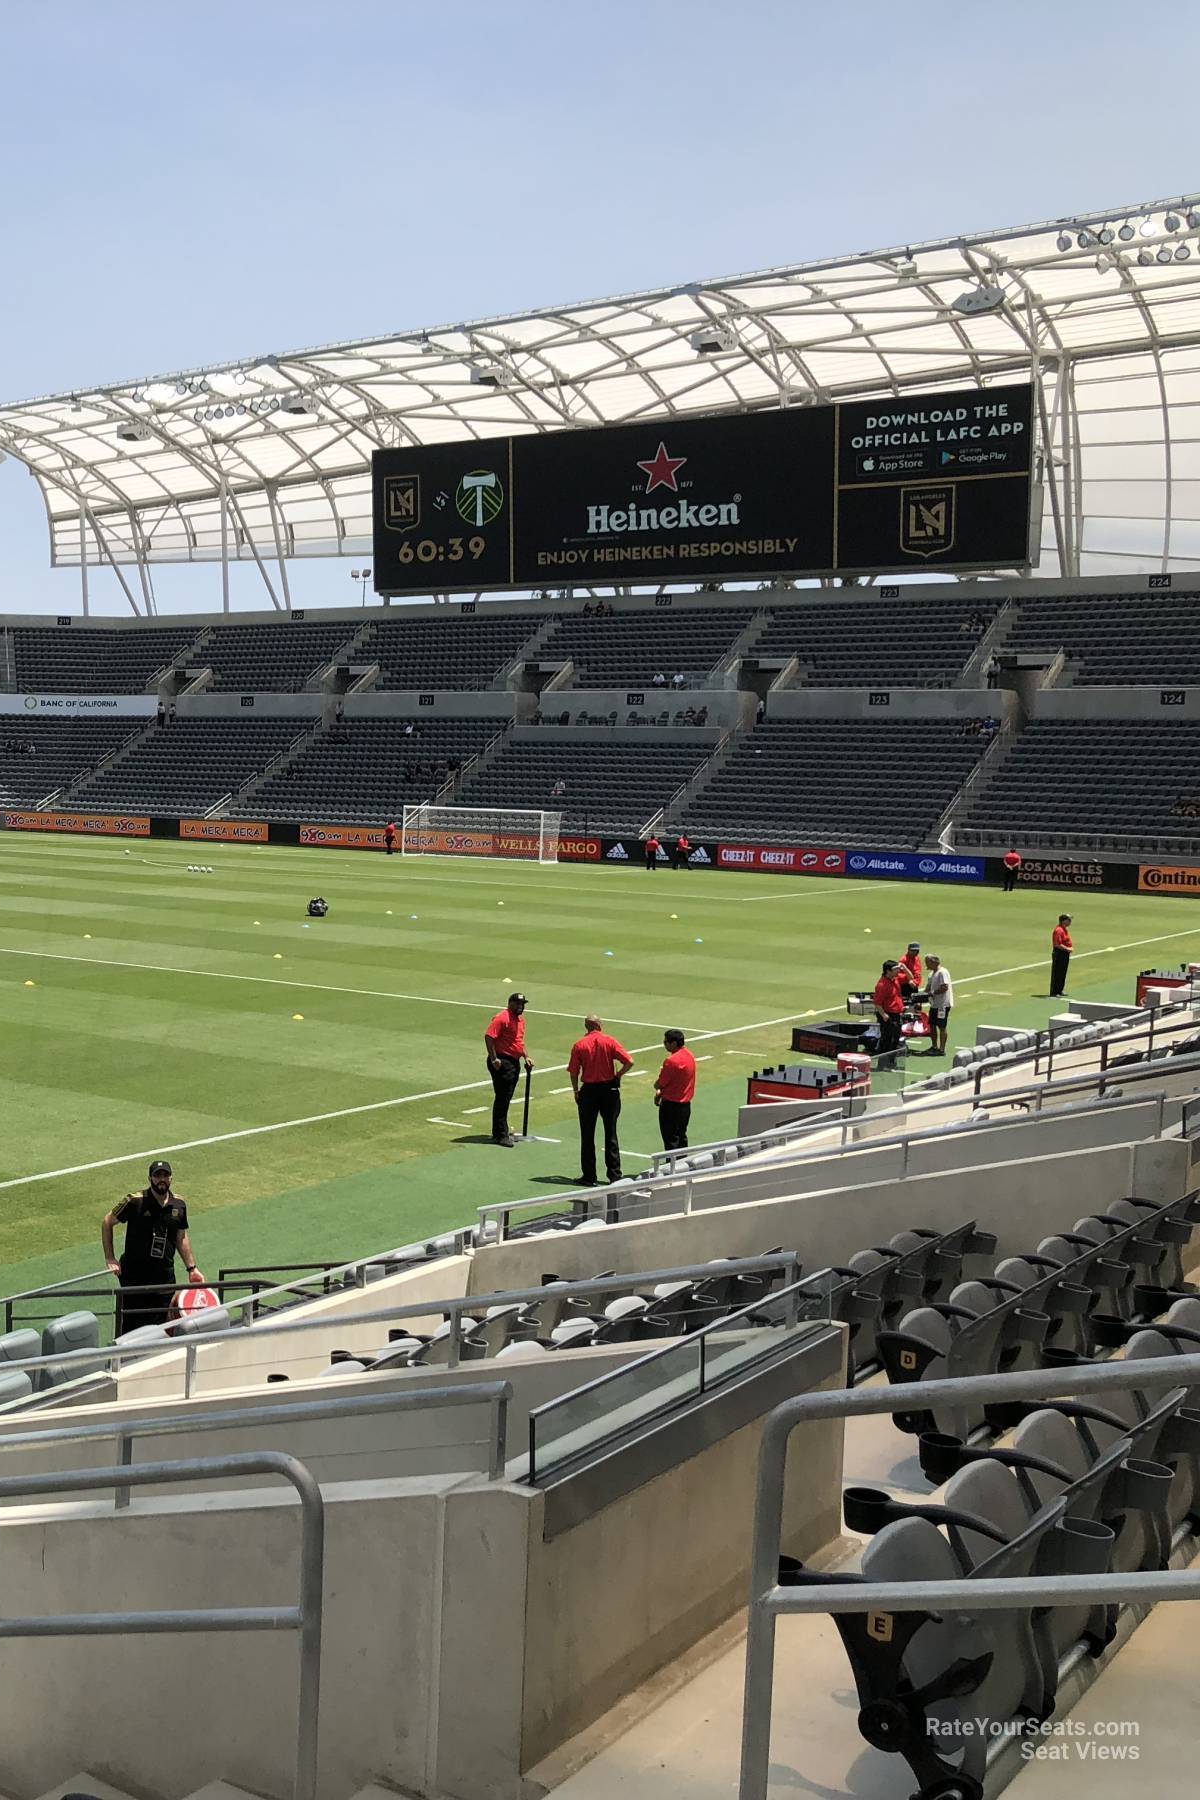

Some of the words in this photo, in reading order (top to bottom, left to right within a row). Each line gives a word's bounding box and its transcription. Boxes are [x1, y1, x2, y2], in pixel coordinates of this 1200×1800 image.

[866, 408, 967, 430] DOWNLOAD
[973, 403, 1009, 420] THE
[851, 430, 930, 449] OFFICIAL
[936, 425, 982, 442] LAFC
[987, 421, 1024, 437] APP
[958, 453, 989, 464] Google
[989, 451, 1007, 462] Play
[878, 460, 898, 472] App
[899, 458, 924, 469] Store
[587, 499, 741, 534] Heineken
[398, 536, 486, 564] 60:39
[537, 549, 590, 566] ENJOY
[593, 544, 675, 563] HEINEKEN
[679, 537, 799, 558] RESPONSIBLY
[1150, 576, 1169, 587] 224
[880, 587, 899, 597] 223
[66, 700, 77, 708] OF
[78, 700, 118, 708] CALIFORNIA
[628, 694, 643, 704] 122
[870, 694, 889, 705] 123
[1162, 693, 1182, 704] 124
[40, 816, 52, 826] LA
[55, 818, 78, 828] MERA
[83, 820, 109, 829] MERA!
[184, 824, 197, 834] LA
[200, 826, 227, 836] MERA
[232, 827, 263, 838] MERA!
[347, 830, 361, 842] LA
[497, 838, 542, 852] WELLS
[548, 840, 598, 855] FARGO
[866, 858, 905, 870] Allstate
[936, 862, 977, 874] Allstate
[1018, 862, 1042, 873] LOS
[1044, 862, 1104, 875] ANGELES
[1016, 872, 1072, 884] FOOTBALL
[1074, 874, 1103, 886] CLUB
[904, 1354, 913, 1365] D
[874, 1616, 886, 1634] E
